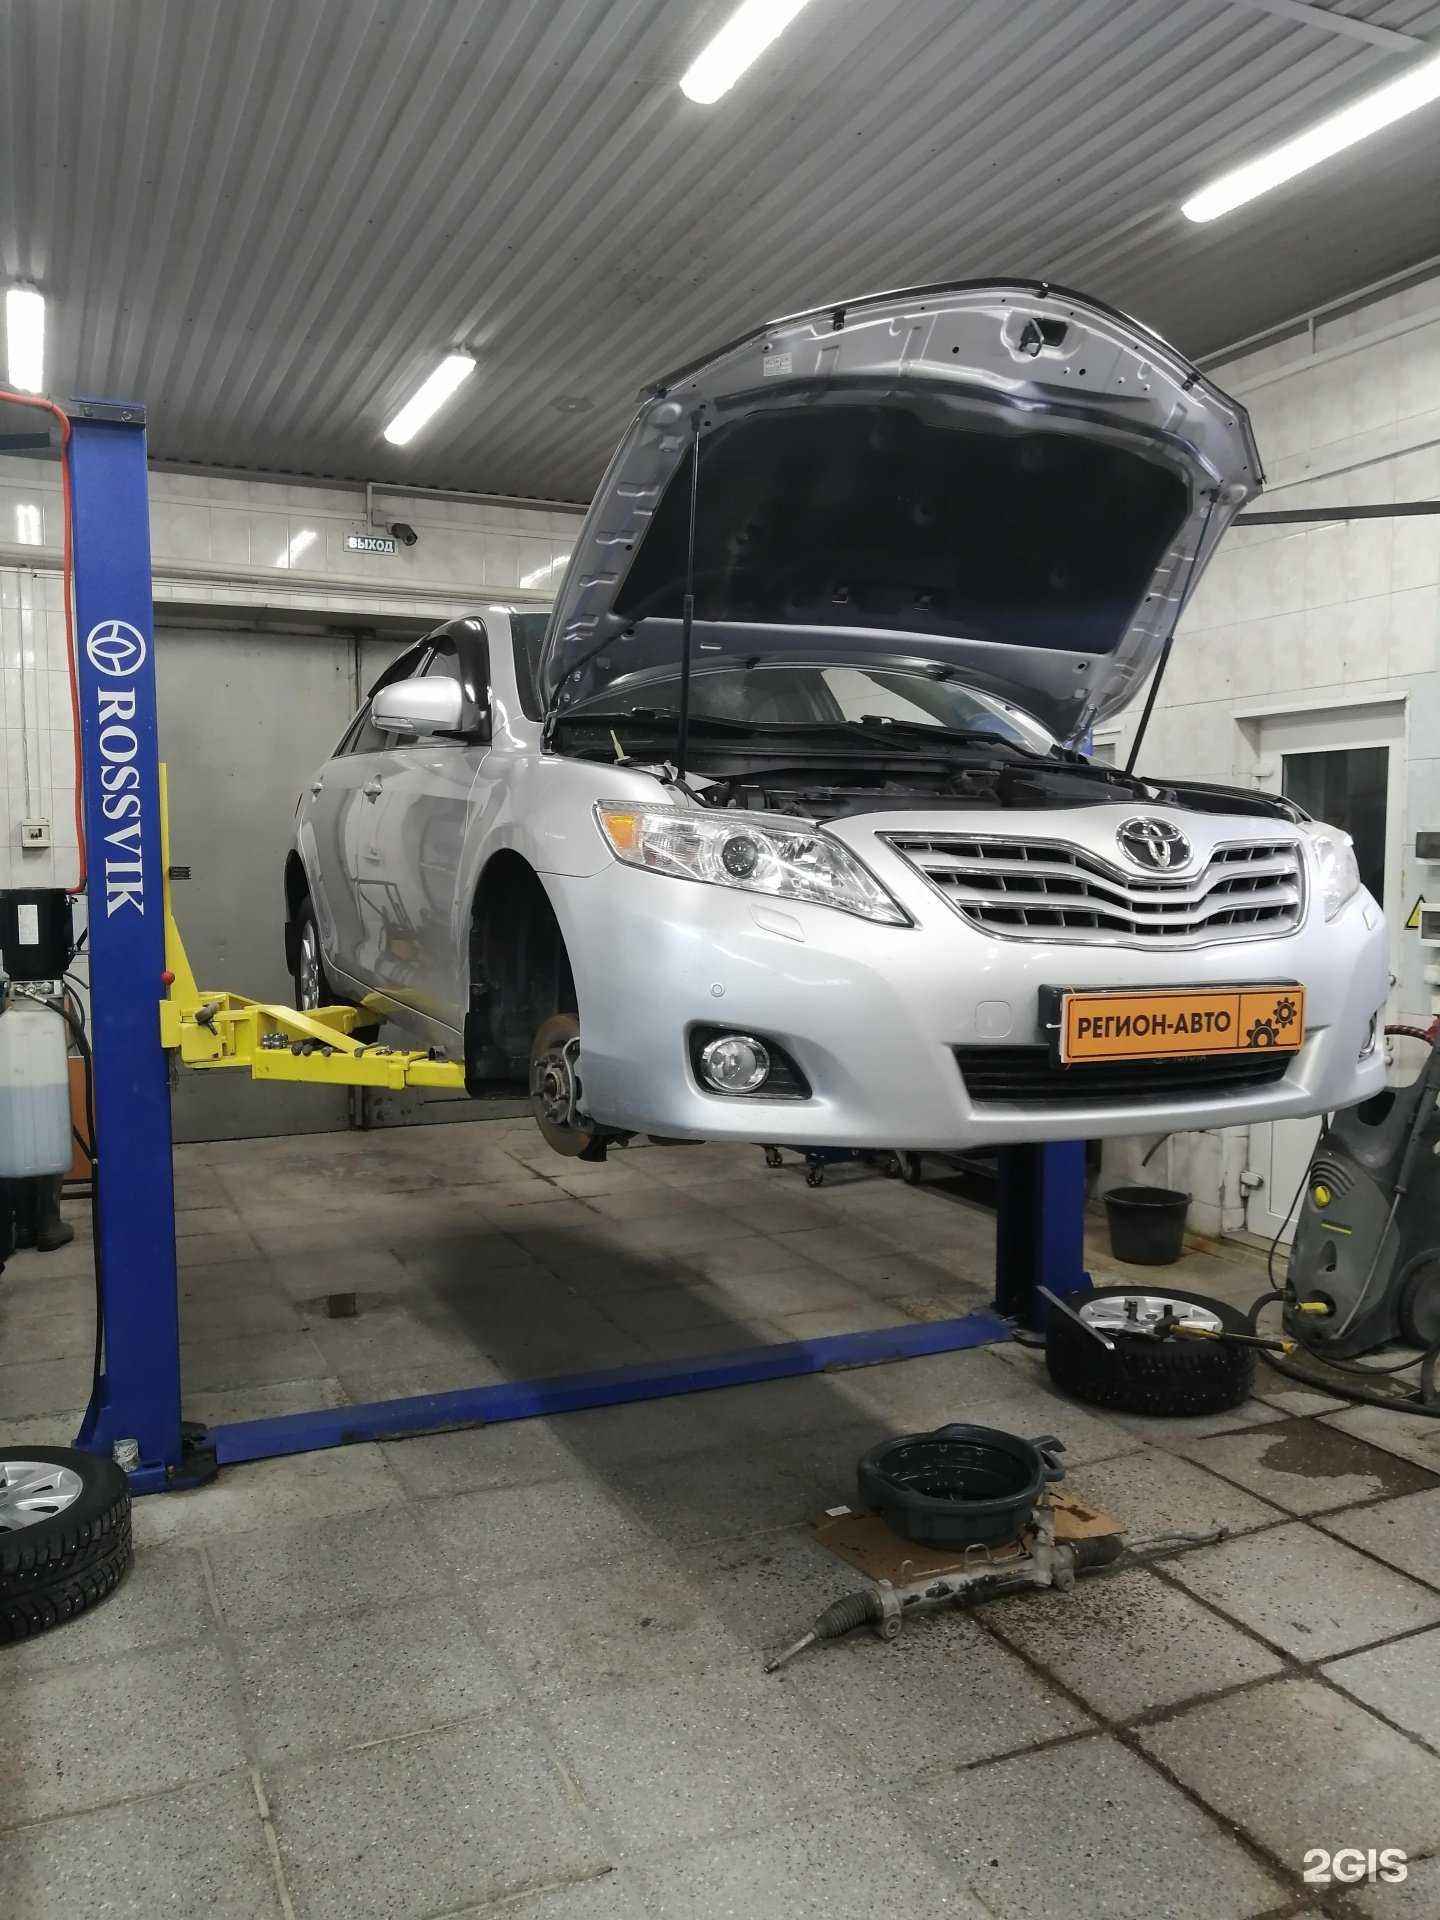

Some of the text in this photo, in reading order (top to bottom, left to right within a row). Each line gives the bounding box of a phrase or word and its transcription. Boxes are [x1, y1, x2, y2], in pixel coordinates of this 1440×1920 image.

[348, 537, 394, 553] ВЫХОД
[97, 686, 145, 919] ROSSVIK
[1077, 1011, 1232, 1039] РЕГИОН-АВТО
